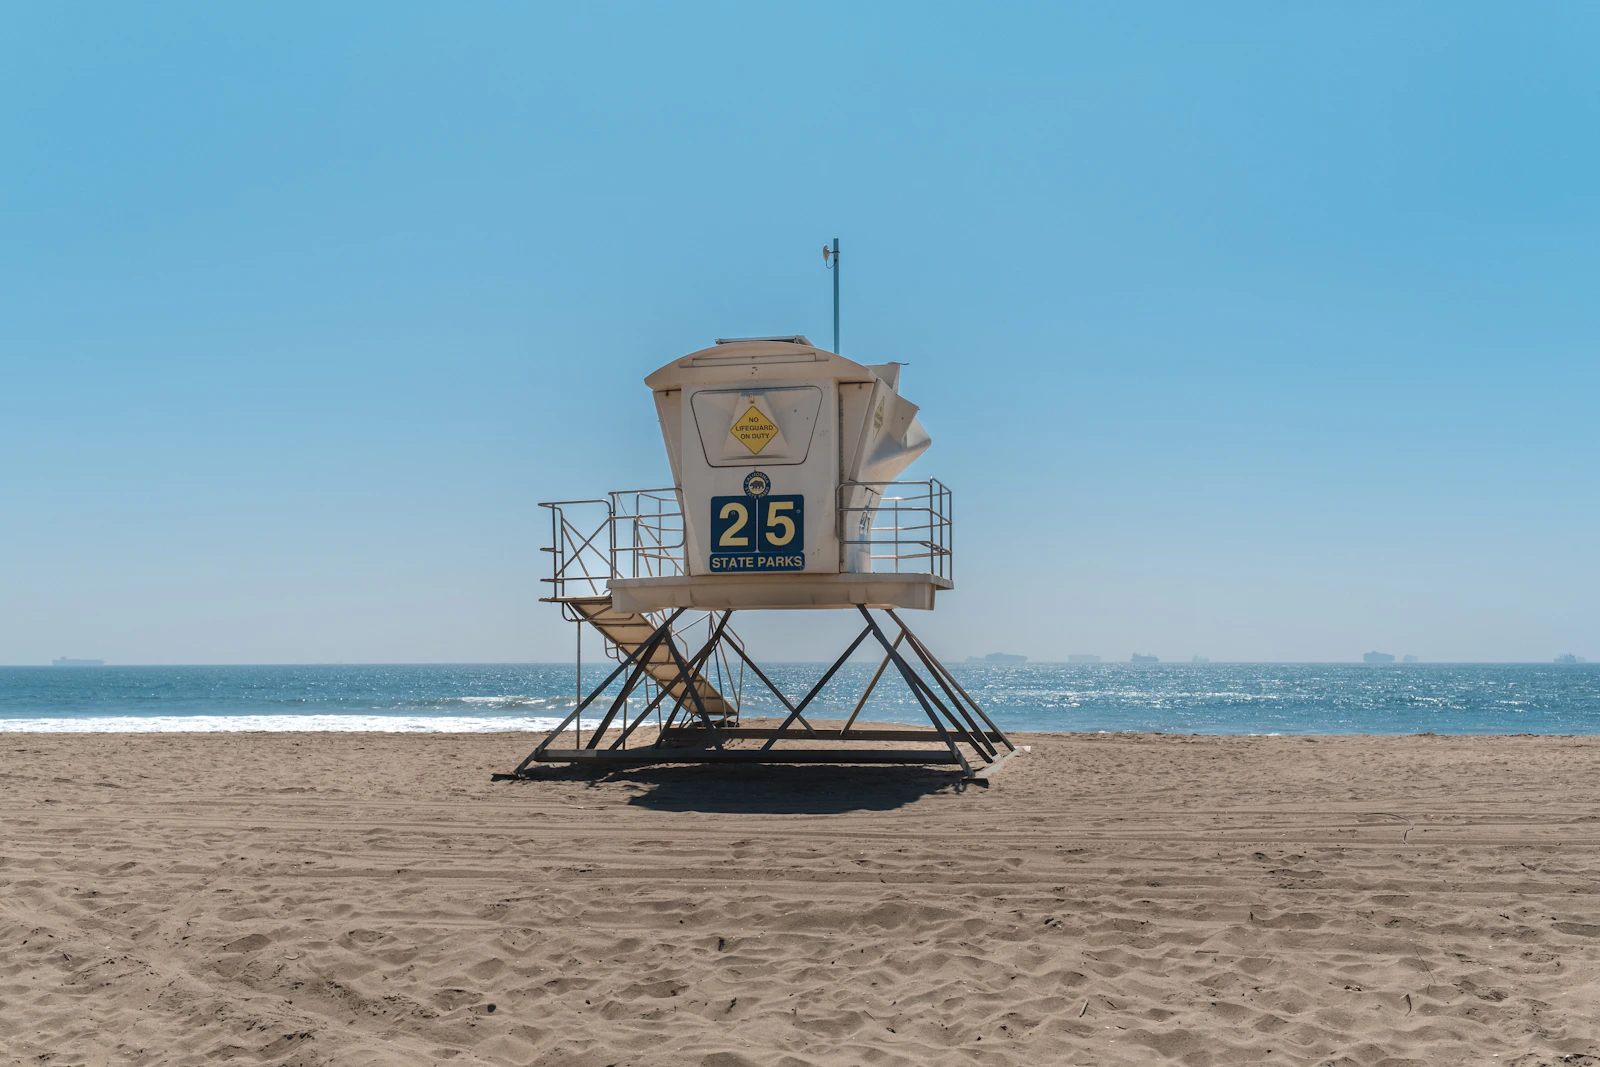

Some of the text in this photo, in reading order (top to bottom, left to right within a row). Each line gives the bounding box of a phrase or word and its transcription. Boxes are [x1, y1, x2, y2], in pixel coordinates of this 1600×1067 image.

[744, 472, 770, 484] CALIFORNIA
[744, 486, 770, 499] STATE PARKS
[719, 502, 795, 546] 25
[712, 556, 802, 568] STATE PARKS
